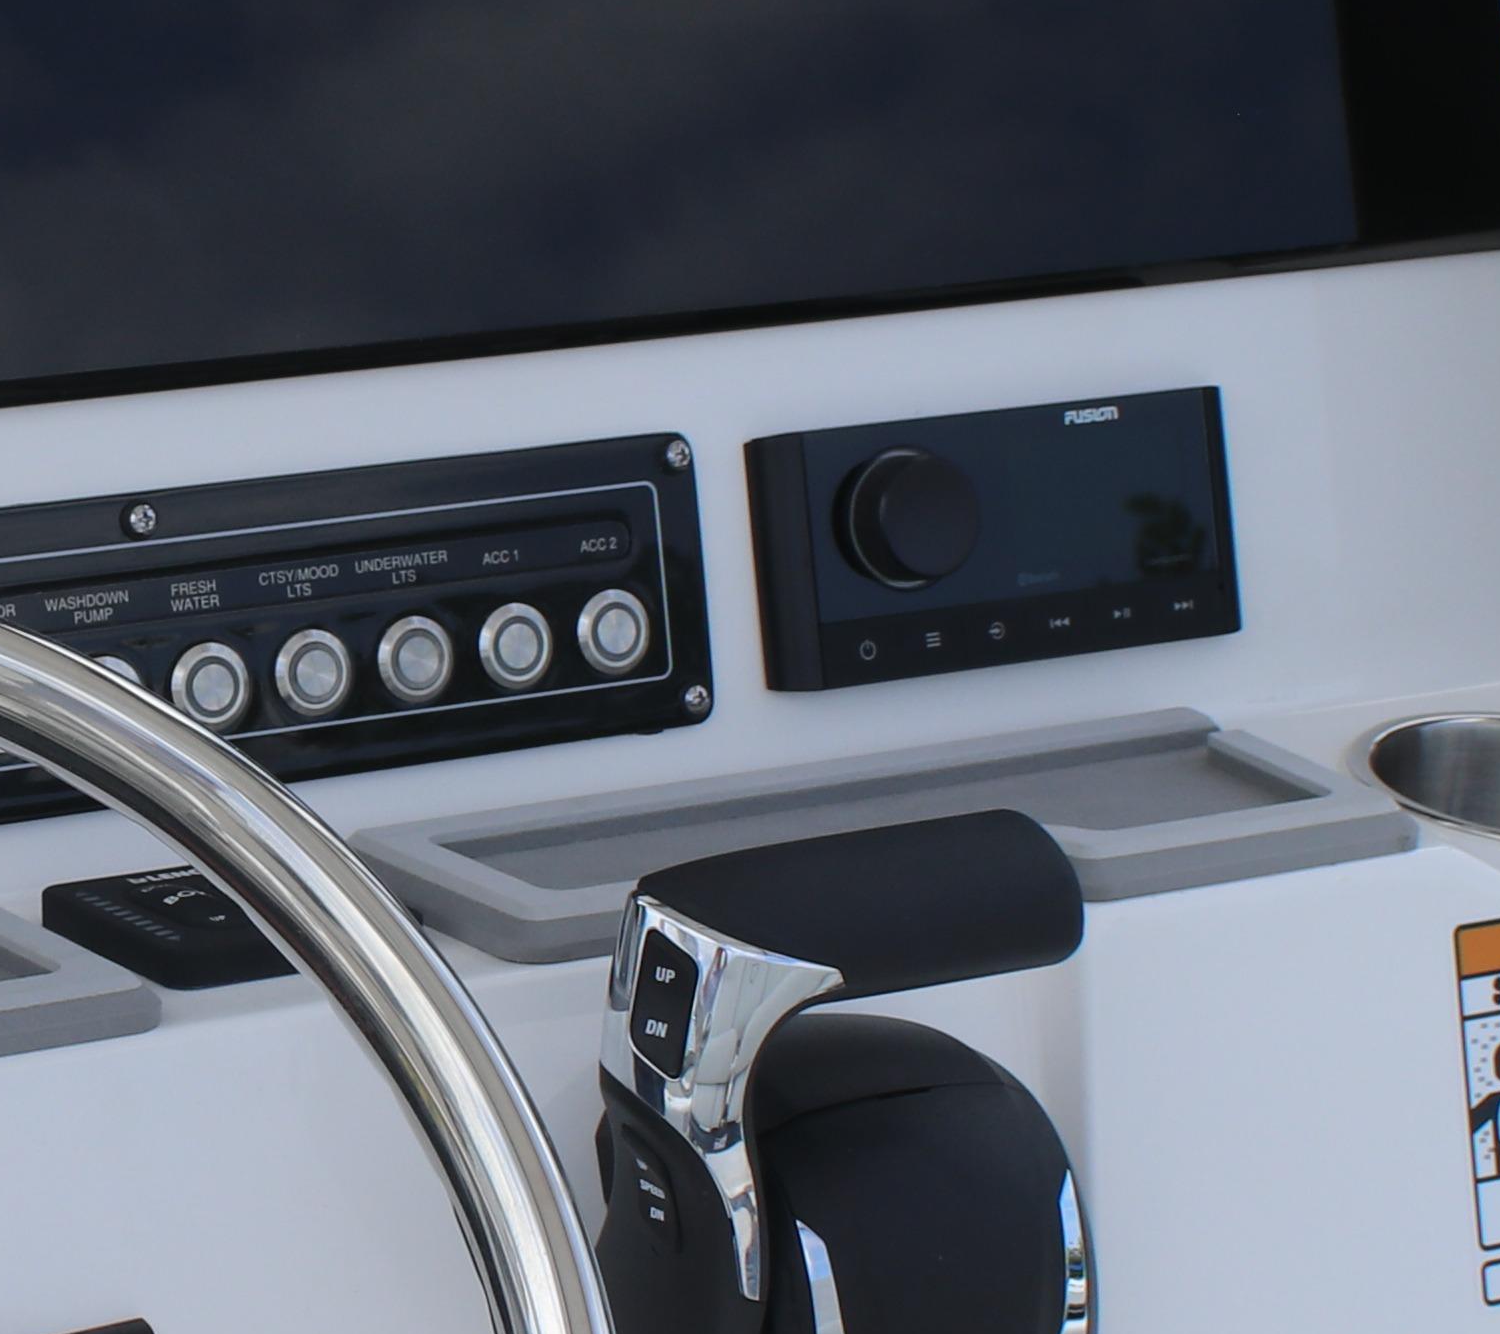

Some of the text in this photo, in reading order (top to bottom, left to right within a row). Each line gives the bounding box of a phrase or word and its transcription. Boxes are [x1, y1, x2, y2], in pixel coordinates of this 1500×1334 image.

[1064, 406, 1118, 425] FUSION
[580, 537, 618, 553] ACC 2
[355, 550, 448, 575] UNDERWATER
[482, 549, 519, 566] ACC 1
[258, 564, 340, 586] CTSY/MOOD
[391, 570, 417, 585] LTS
[170, 579, 217, 597] FRESH
[286, 583, 312, 598] LTS
[44, 590, 129, 612] WASHDOWN
[170, 594, 220, 612] WATER
[74, 608, 113, 625] PUMP
[655, 966, 676, 983] UP
[645, 1019, 668, 1038] DN
